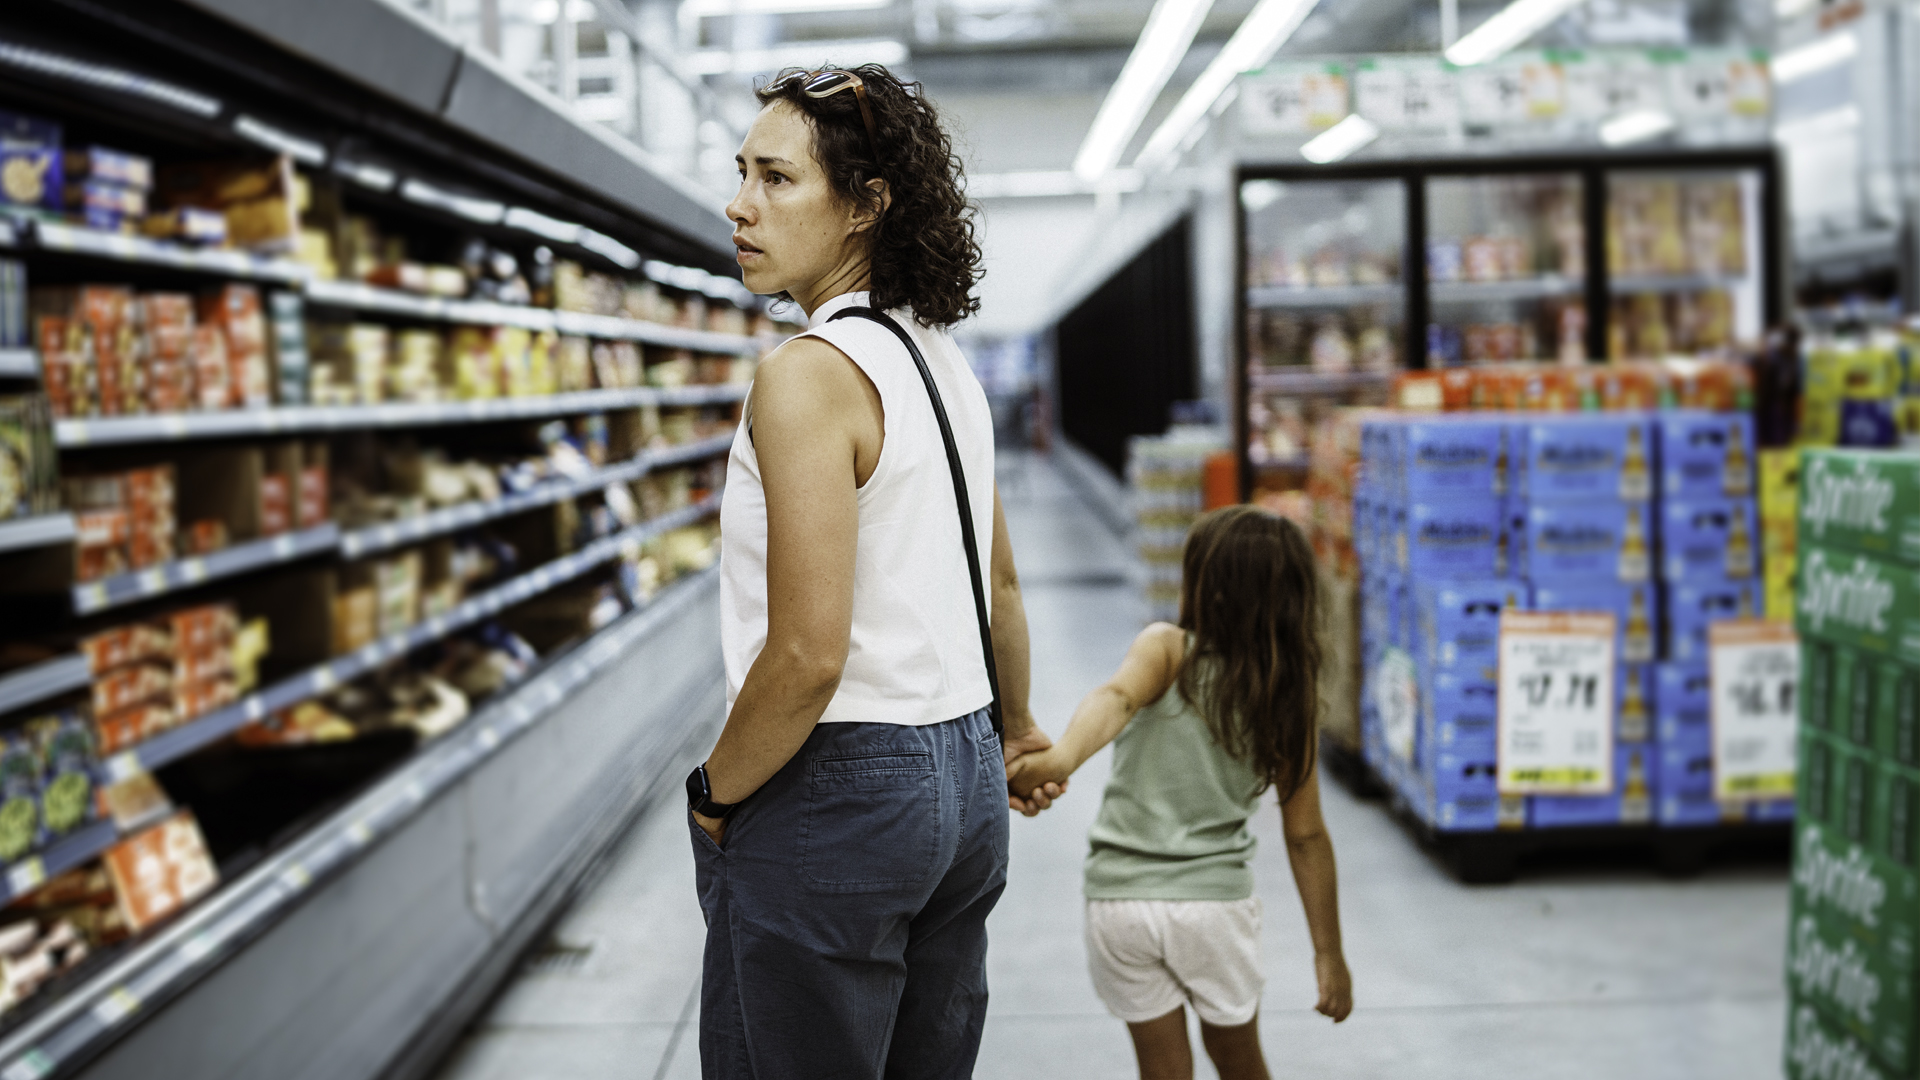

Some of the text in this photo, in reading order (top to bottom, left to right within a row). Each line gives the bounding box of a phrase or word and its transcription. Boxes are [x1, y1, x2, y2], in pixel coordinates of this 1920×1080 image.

[1801, 456, 1895, 539] Sprite
[1799, 550, 1894, 633] Sprite
[1795, 825, 1886, 928] Sprite
[1792, 914, 1881, 1024] Sprite
[1791, 1006, 1882, 1080] Spri
